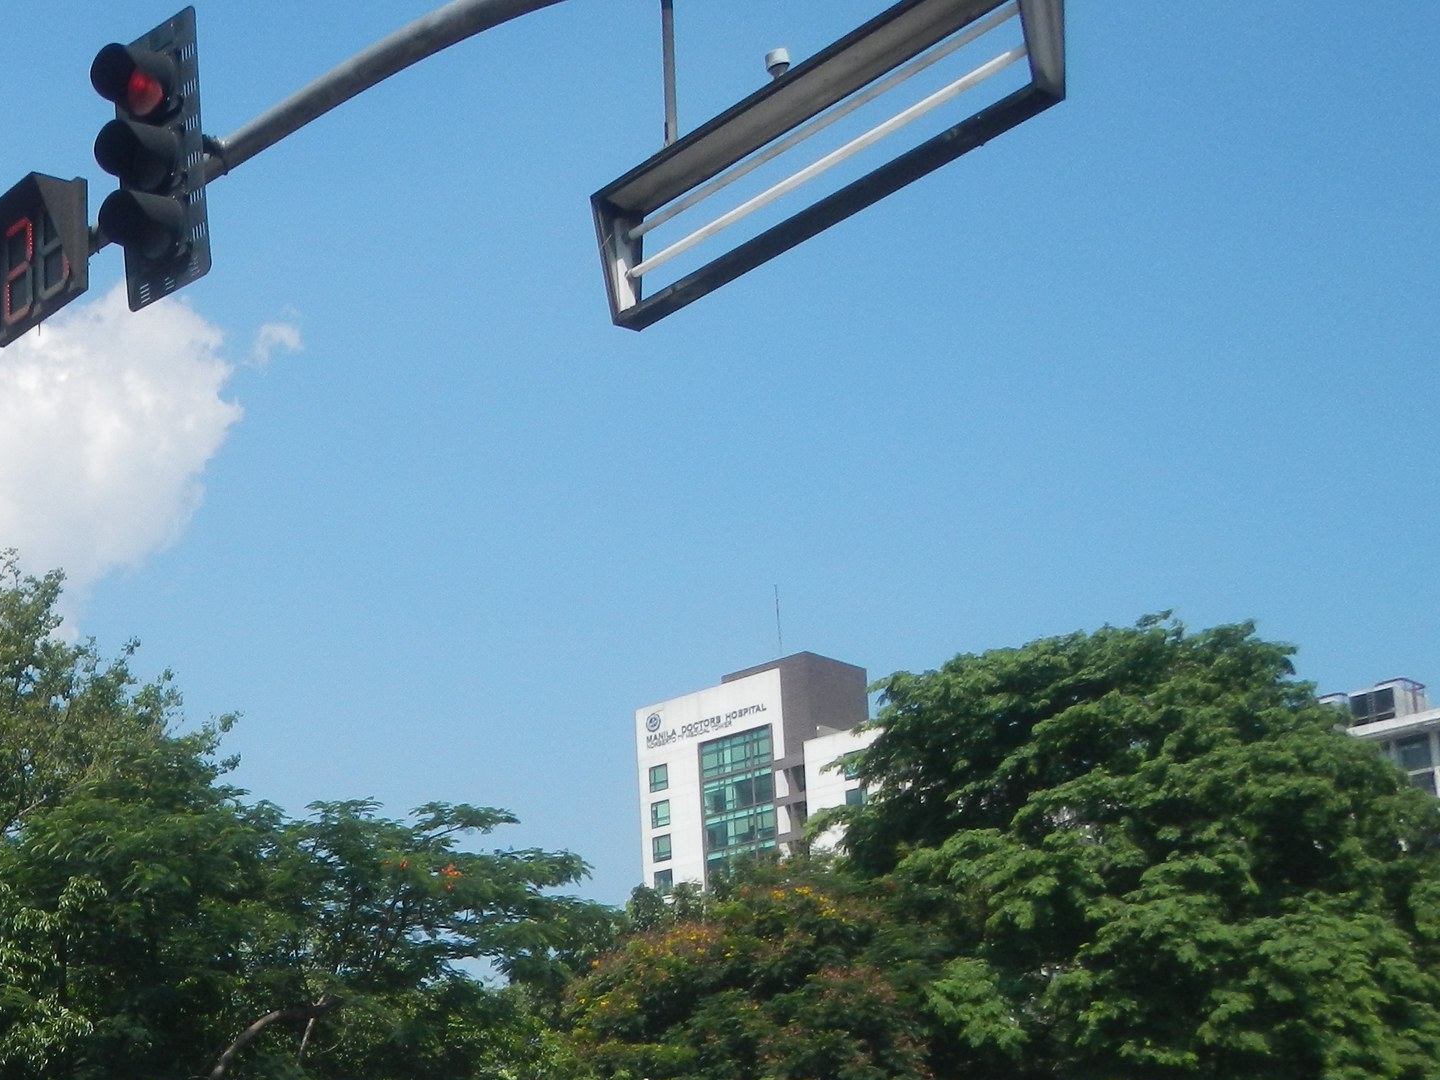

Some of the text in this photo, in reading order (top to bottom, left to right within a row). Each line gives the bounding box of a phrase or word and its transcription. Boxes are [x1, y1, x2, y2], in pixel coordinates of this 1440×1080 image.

[646, 703, 767, 743] MANILA DOCTORS HOSPITAL
